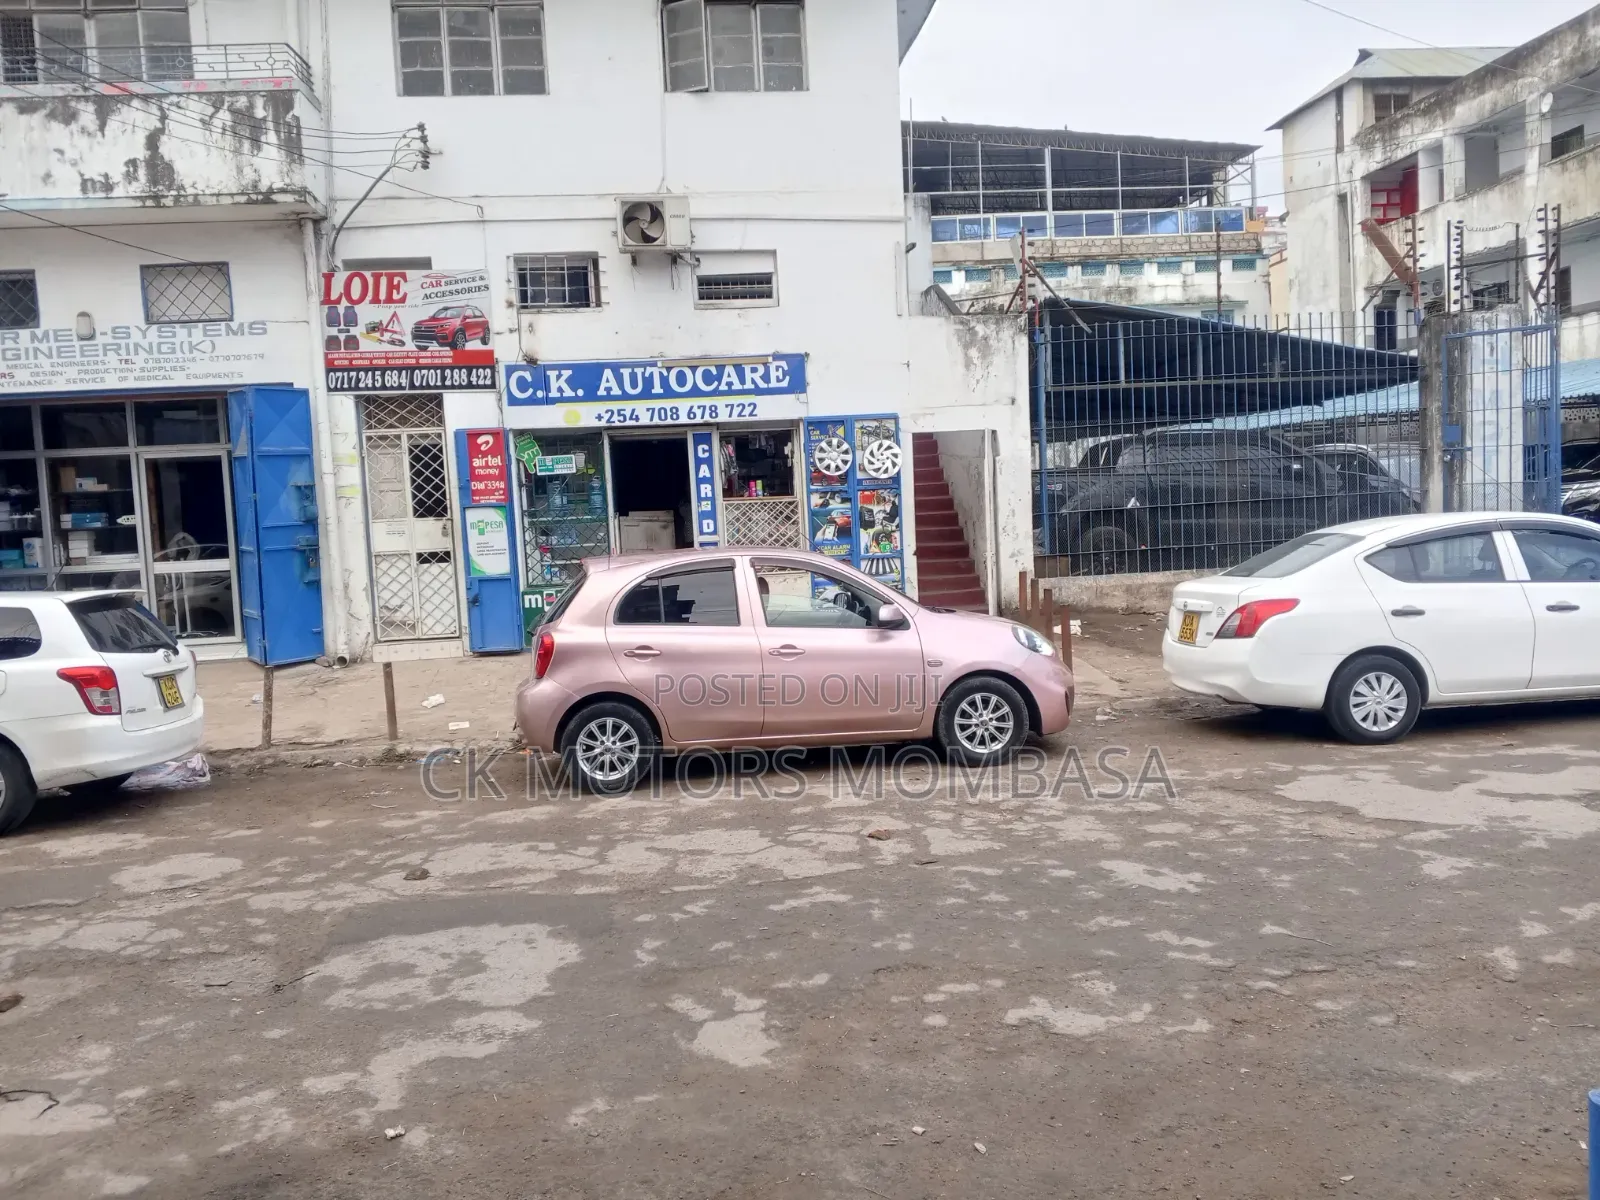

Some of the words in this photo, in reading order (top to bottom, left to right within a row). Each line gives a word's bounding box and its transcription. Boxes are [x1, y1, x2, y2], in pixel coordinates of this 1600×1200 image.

[320, 272, 408, 305] LOIE
[421, 280, 443, 289] CAR
[444, 276, 478, 286] SERVICE
[422, 284, 490, 300] ACCESSORIES
[6, 362, 44, 370] MEDICAL
[65, 376, 106, 385] SERVICE
[134, 373, 174, 381] MEDICAL
[328, 371, 357, 389] 0717
[358, 370, 382, 388] 245
[413, 368, 442, 387] 0701
[444, 368, 468, 386] 288
[470, 367, 492, 385] 422
[596, 360, 790, 396] AUTOCARE
[595, 408, 640, 424] +254
[646, 406, 680, 422] 708
[686, 404, 719, 420] 678
[725, 402, 758, 418] 722
[472, 455, 502, 467] airtel
[475, 468, 499, 476] money
